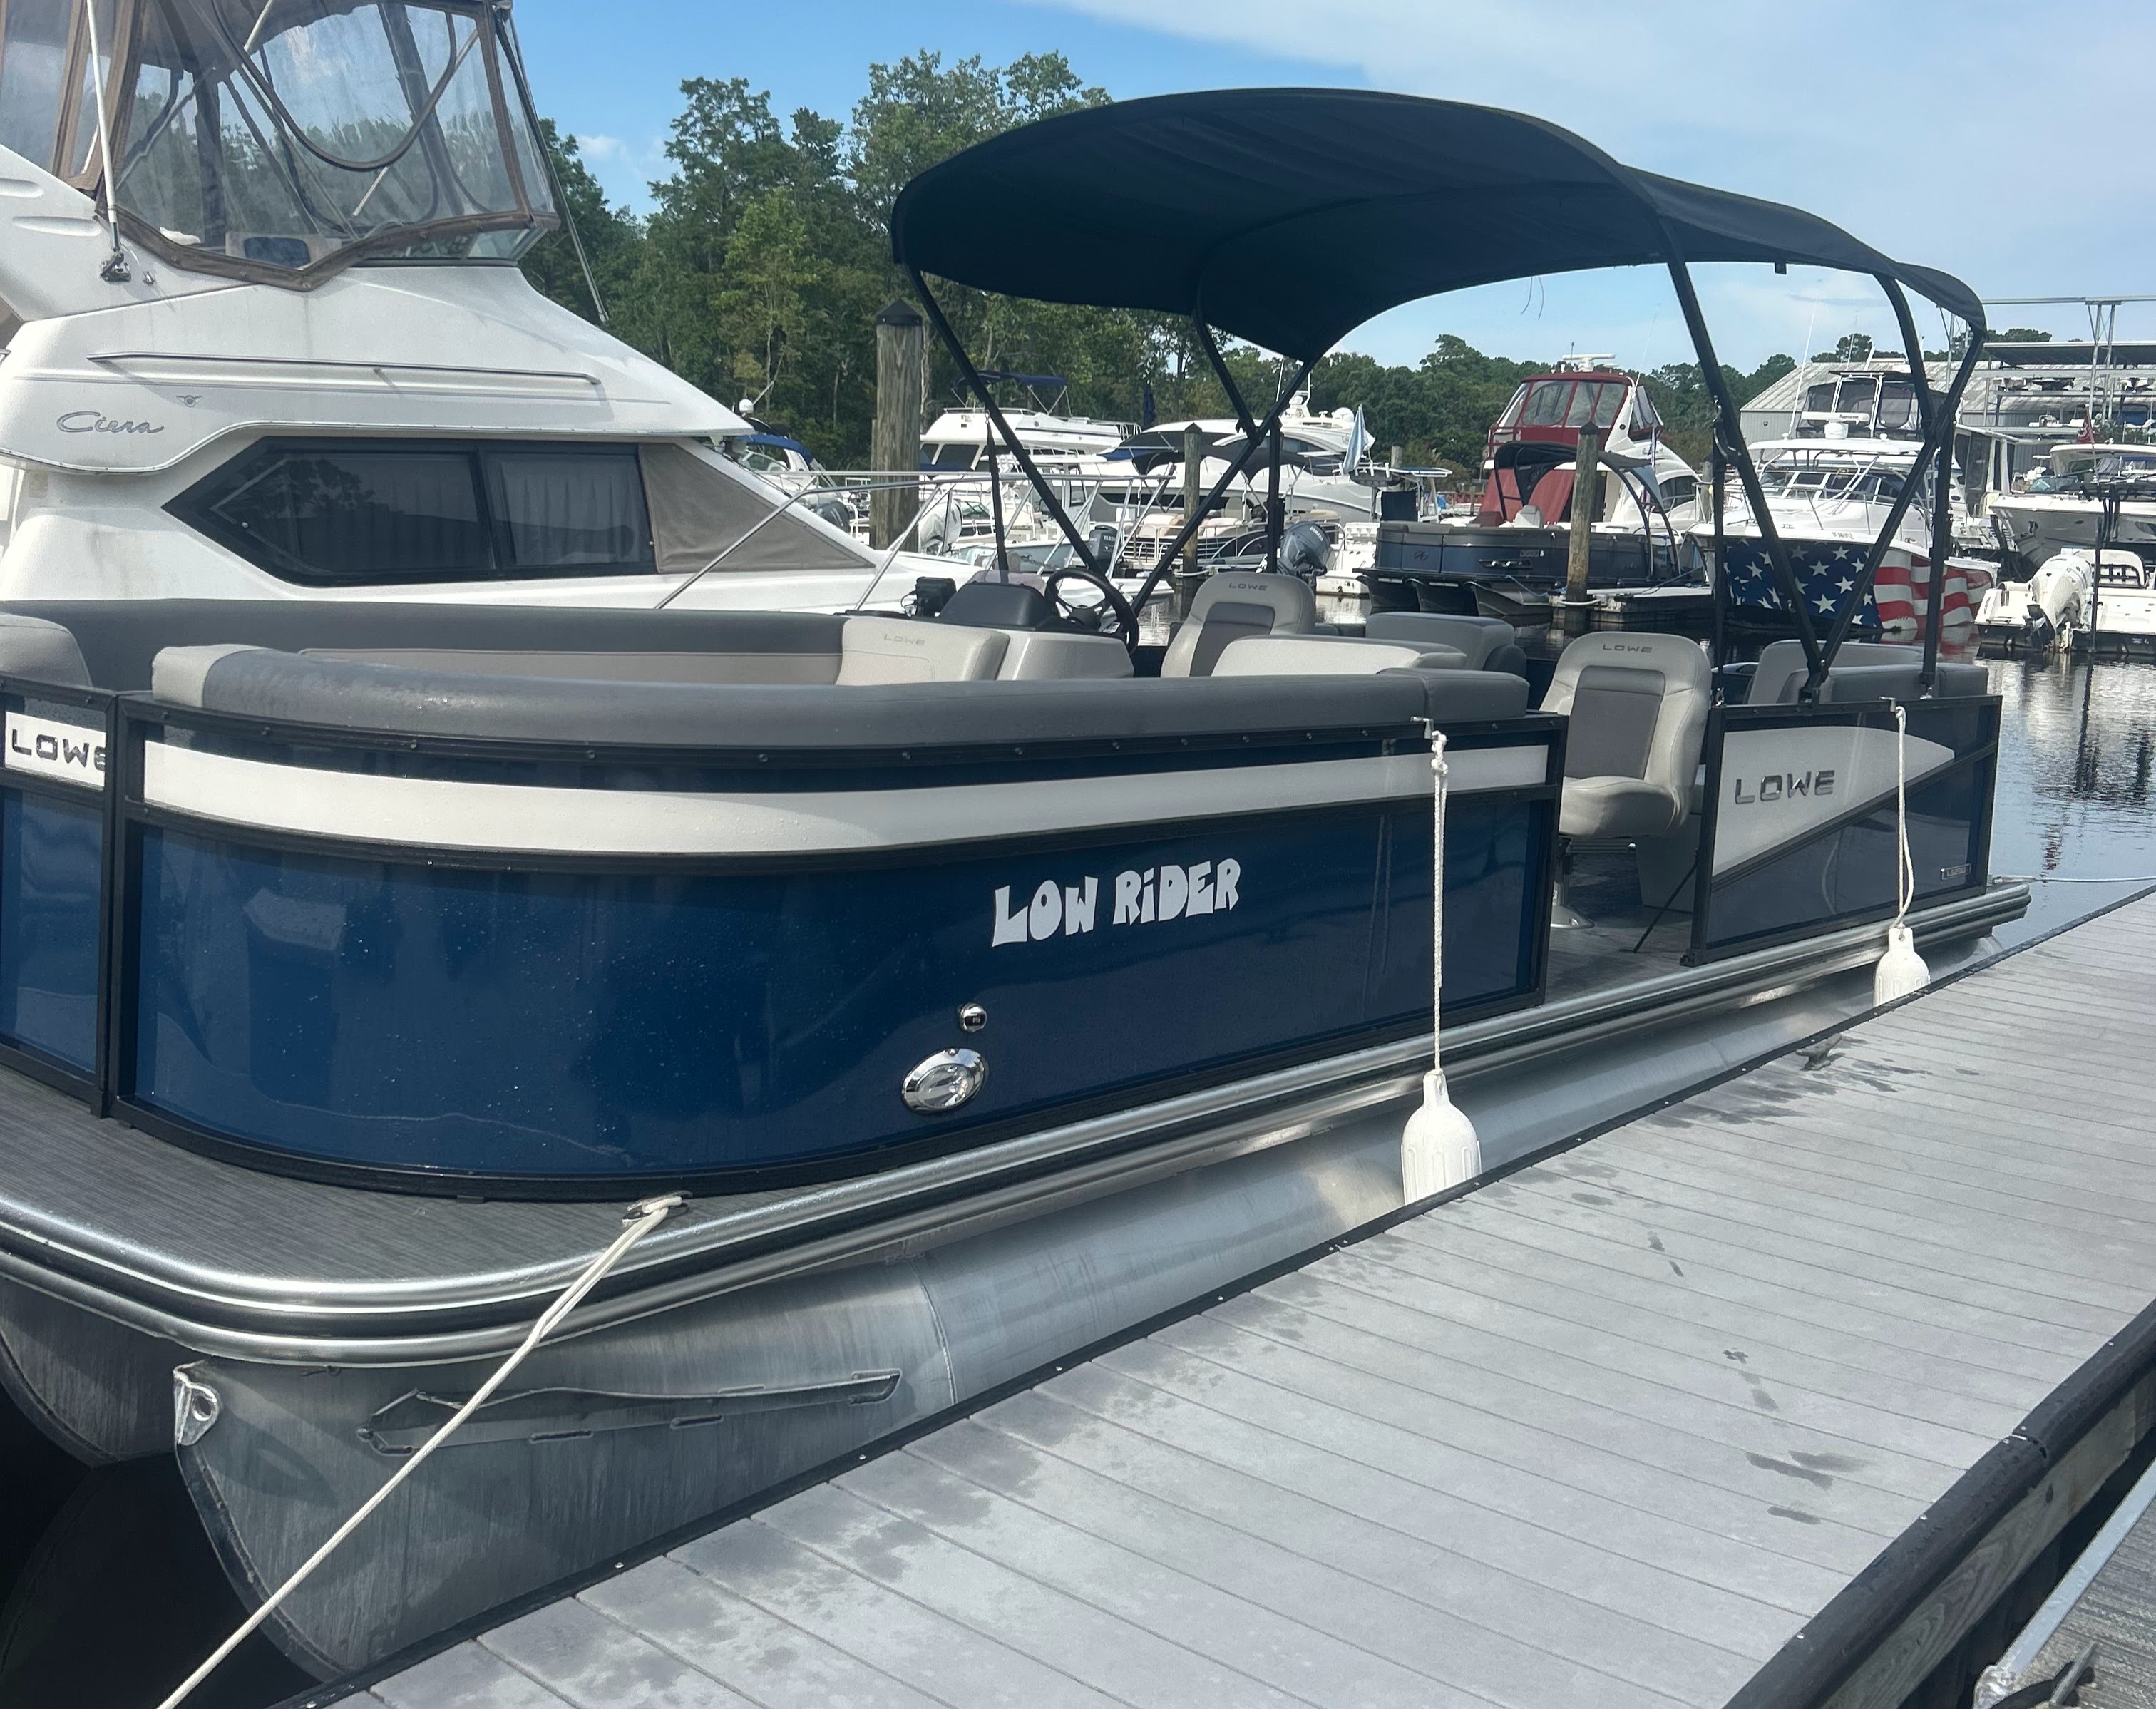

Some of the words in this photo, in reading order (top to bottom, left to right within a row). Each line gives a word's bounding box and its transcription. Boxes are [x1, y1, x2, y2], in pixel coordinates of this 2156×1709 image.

[56, 411, 164, 433] Ciera
[1228, 583, 1268, 591] LOWE
[884, 634, 925, 645] LOWE
[1603, 645, 1653, 653] LOWE
[1735, 770, 1835, 804] LOWE
[992, 876, 1099, 948] LOW
